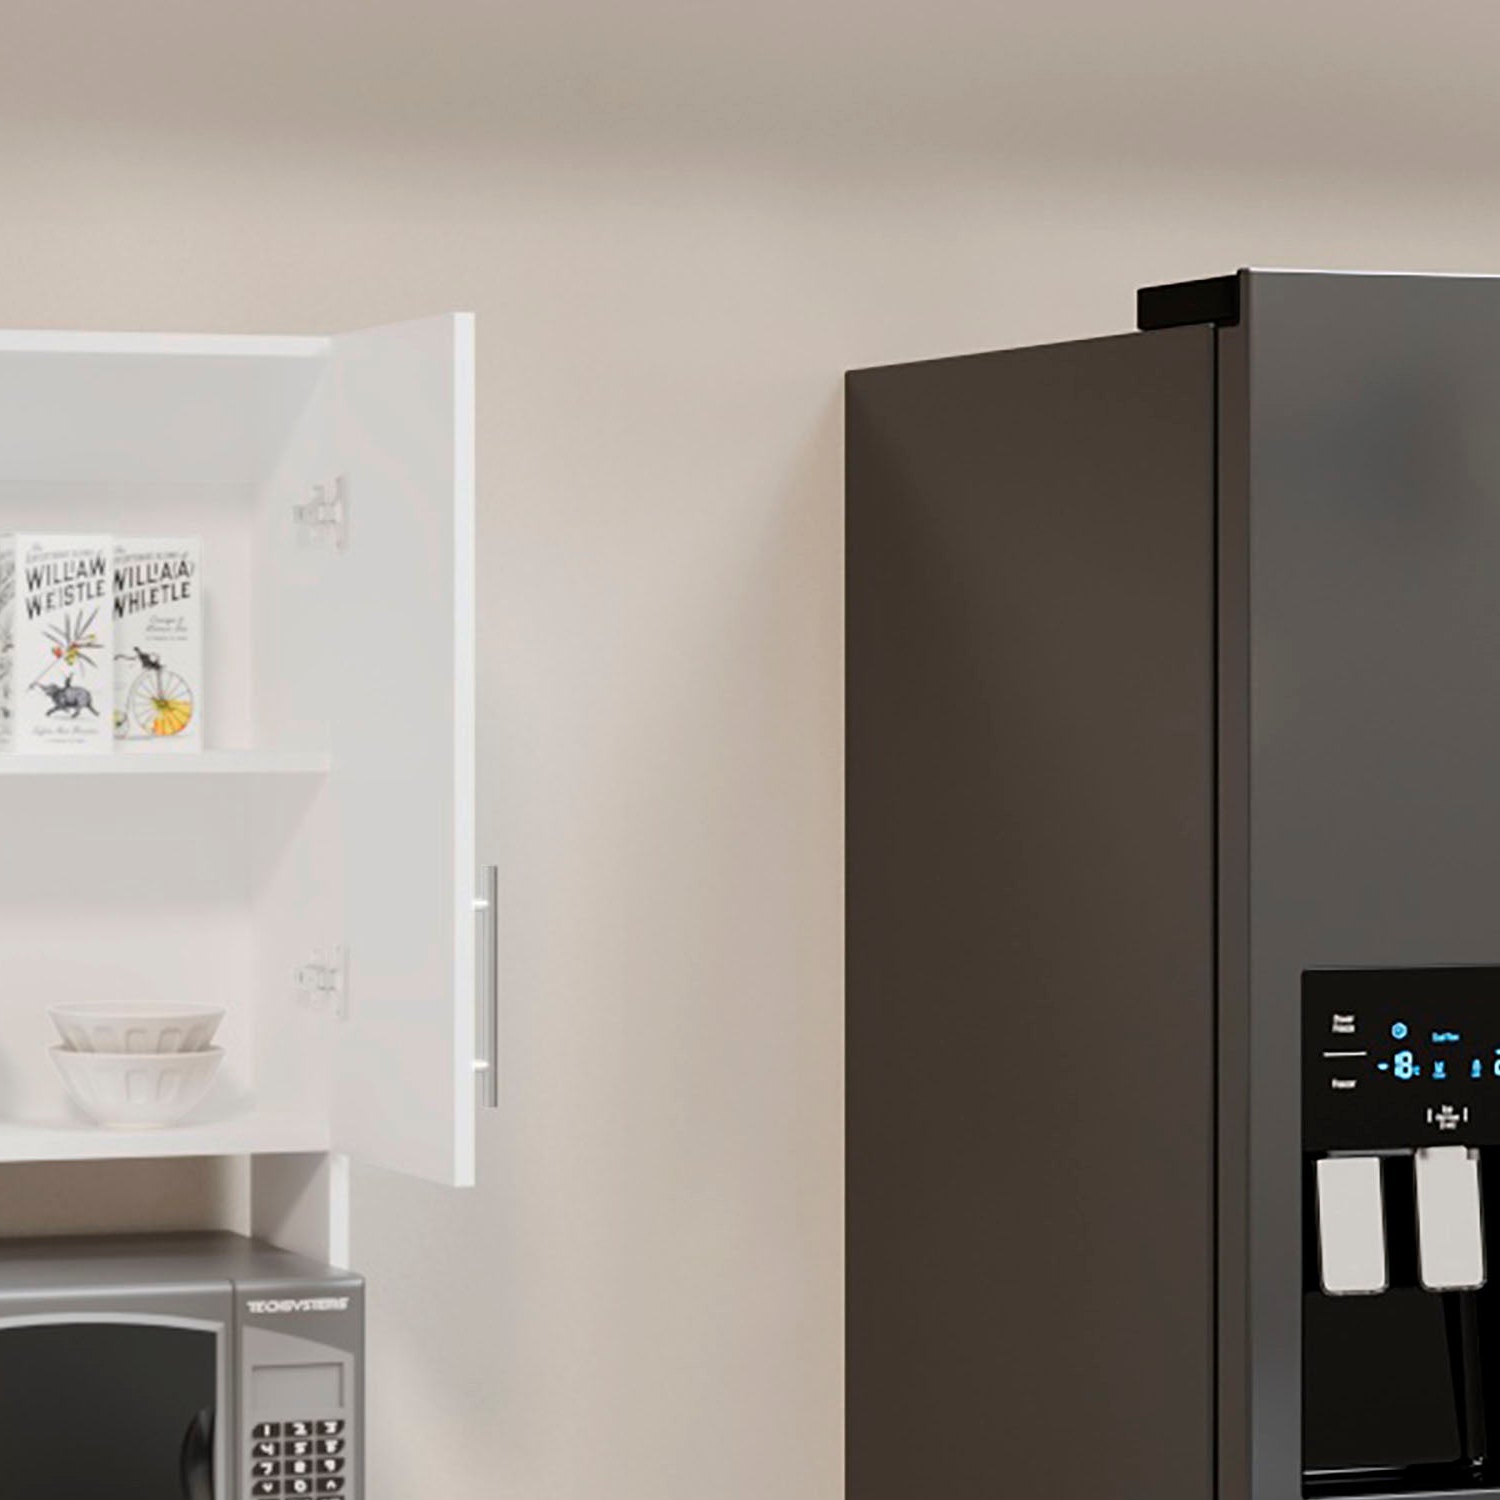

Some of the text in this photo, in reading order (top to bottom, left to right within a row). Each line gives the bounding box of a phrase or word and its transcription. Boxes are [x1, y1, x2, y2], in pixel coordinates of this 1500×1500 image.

[293, 1422, 307, 1436] 2
[260, 1442, 275, 1456] 4
[260, 1462, 274, 1476] 7
